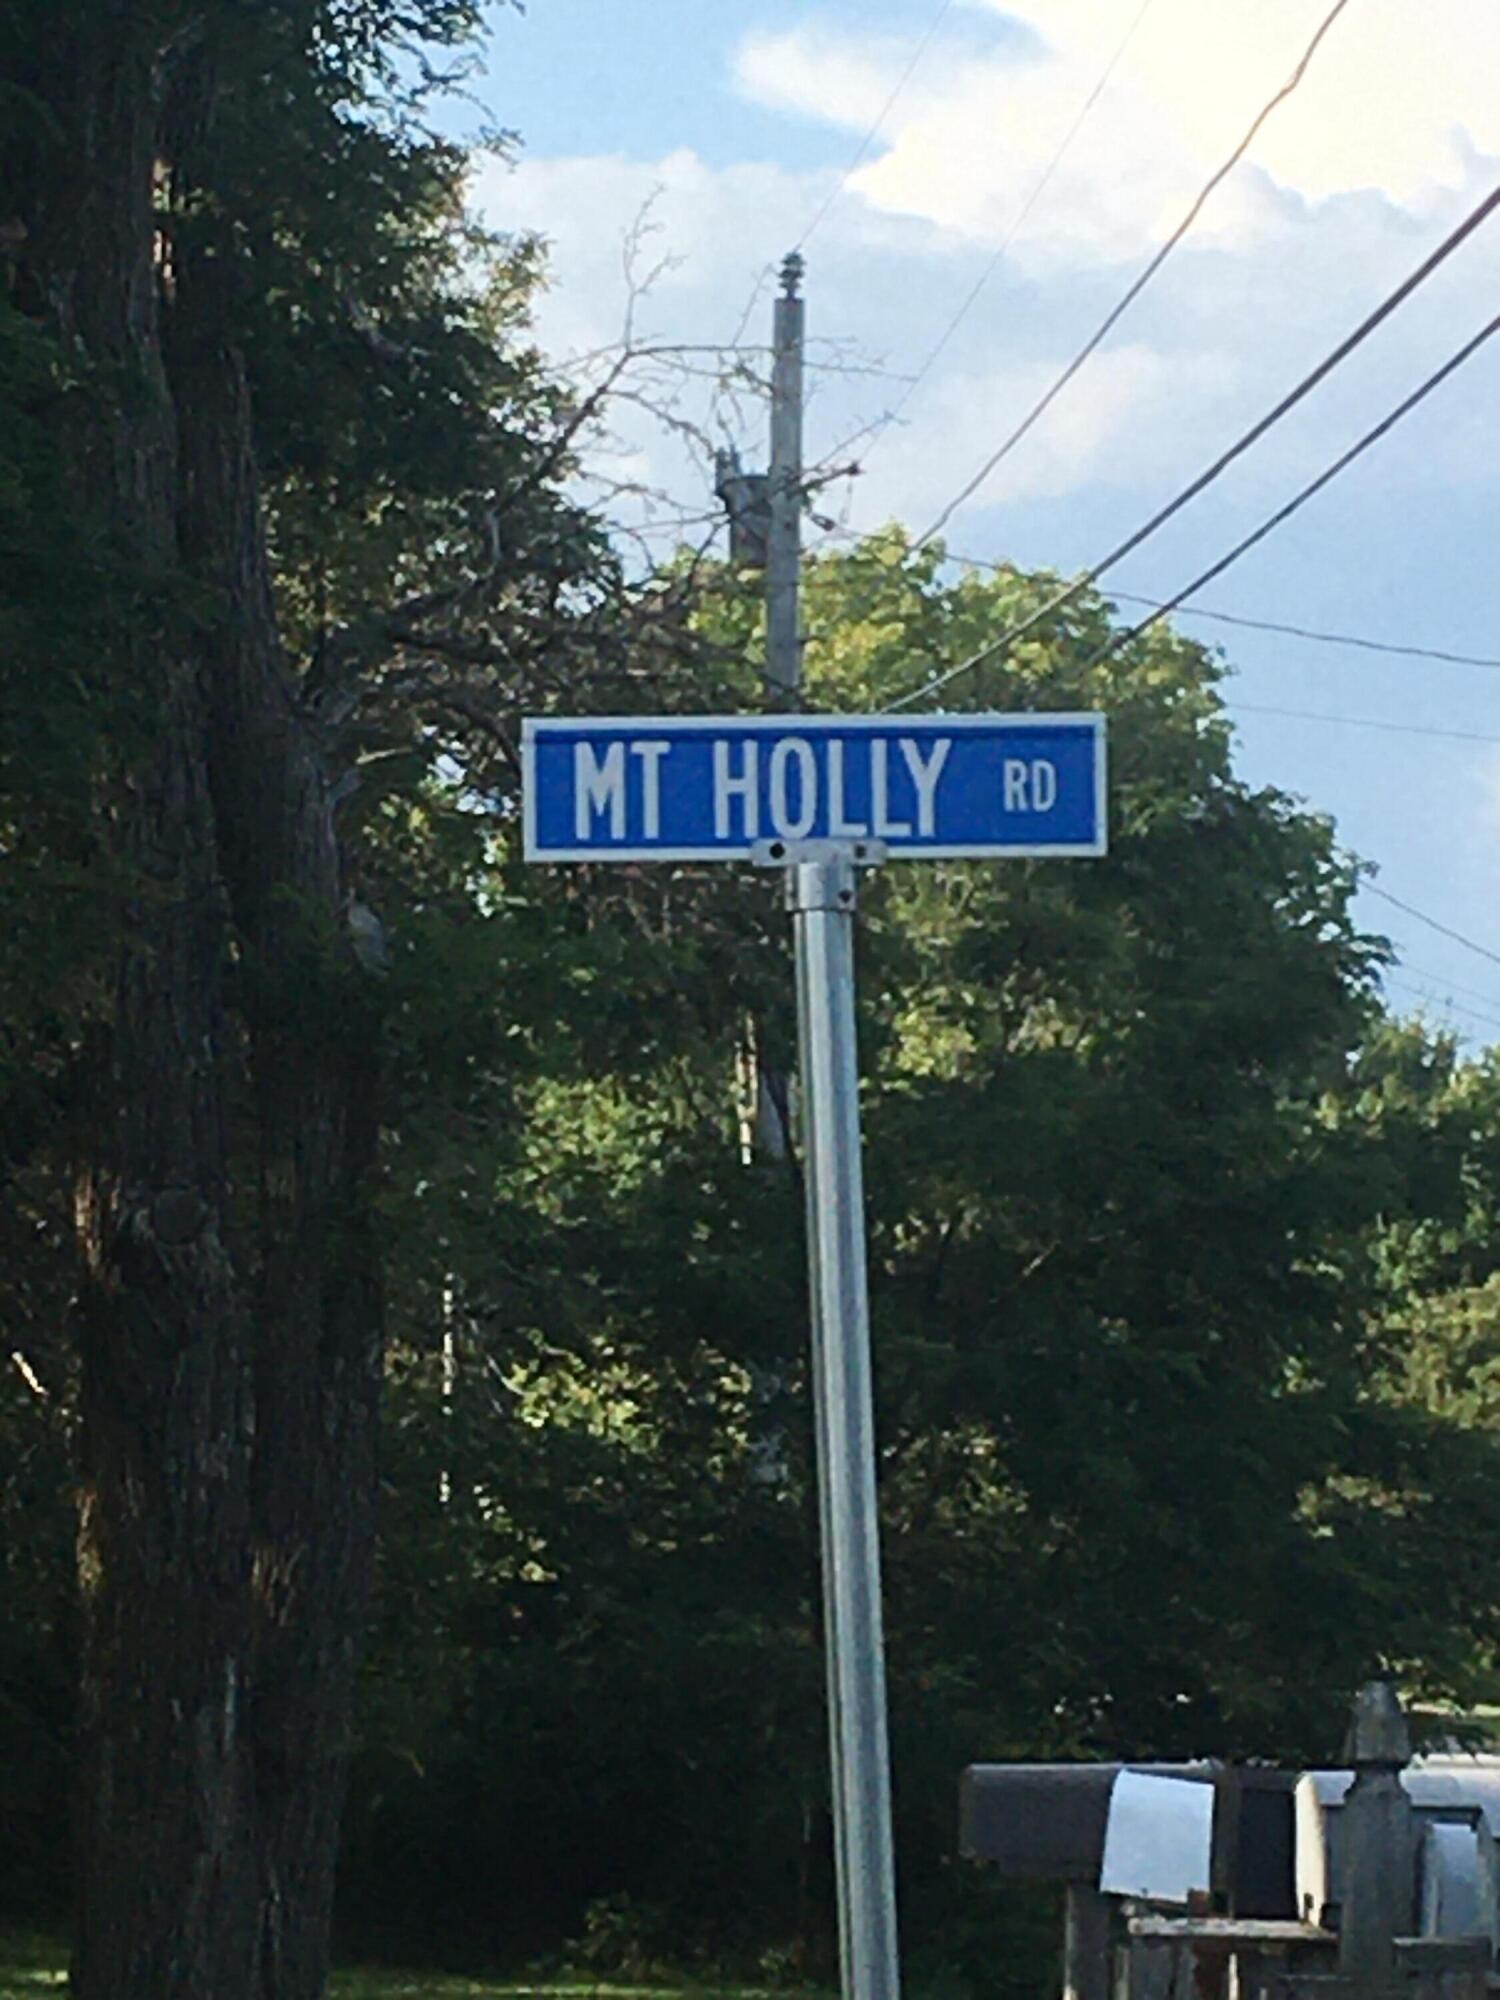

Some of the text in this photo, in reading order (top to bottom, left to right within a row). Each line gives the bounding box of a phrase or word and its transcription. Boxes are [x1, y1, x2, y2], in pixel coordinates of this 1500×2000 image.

[573, 737, 1057, 840] MT HOLLY RD
